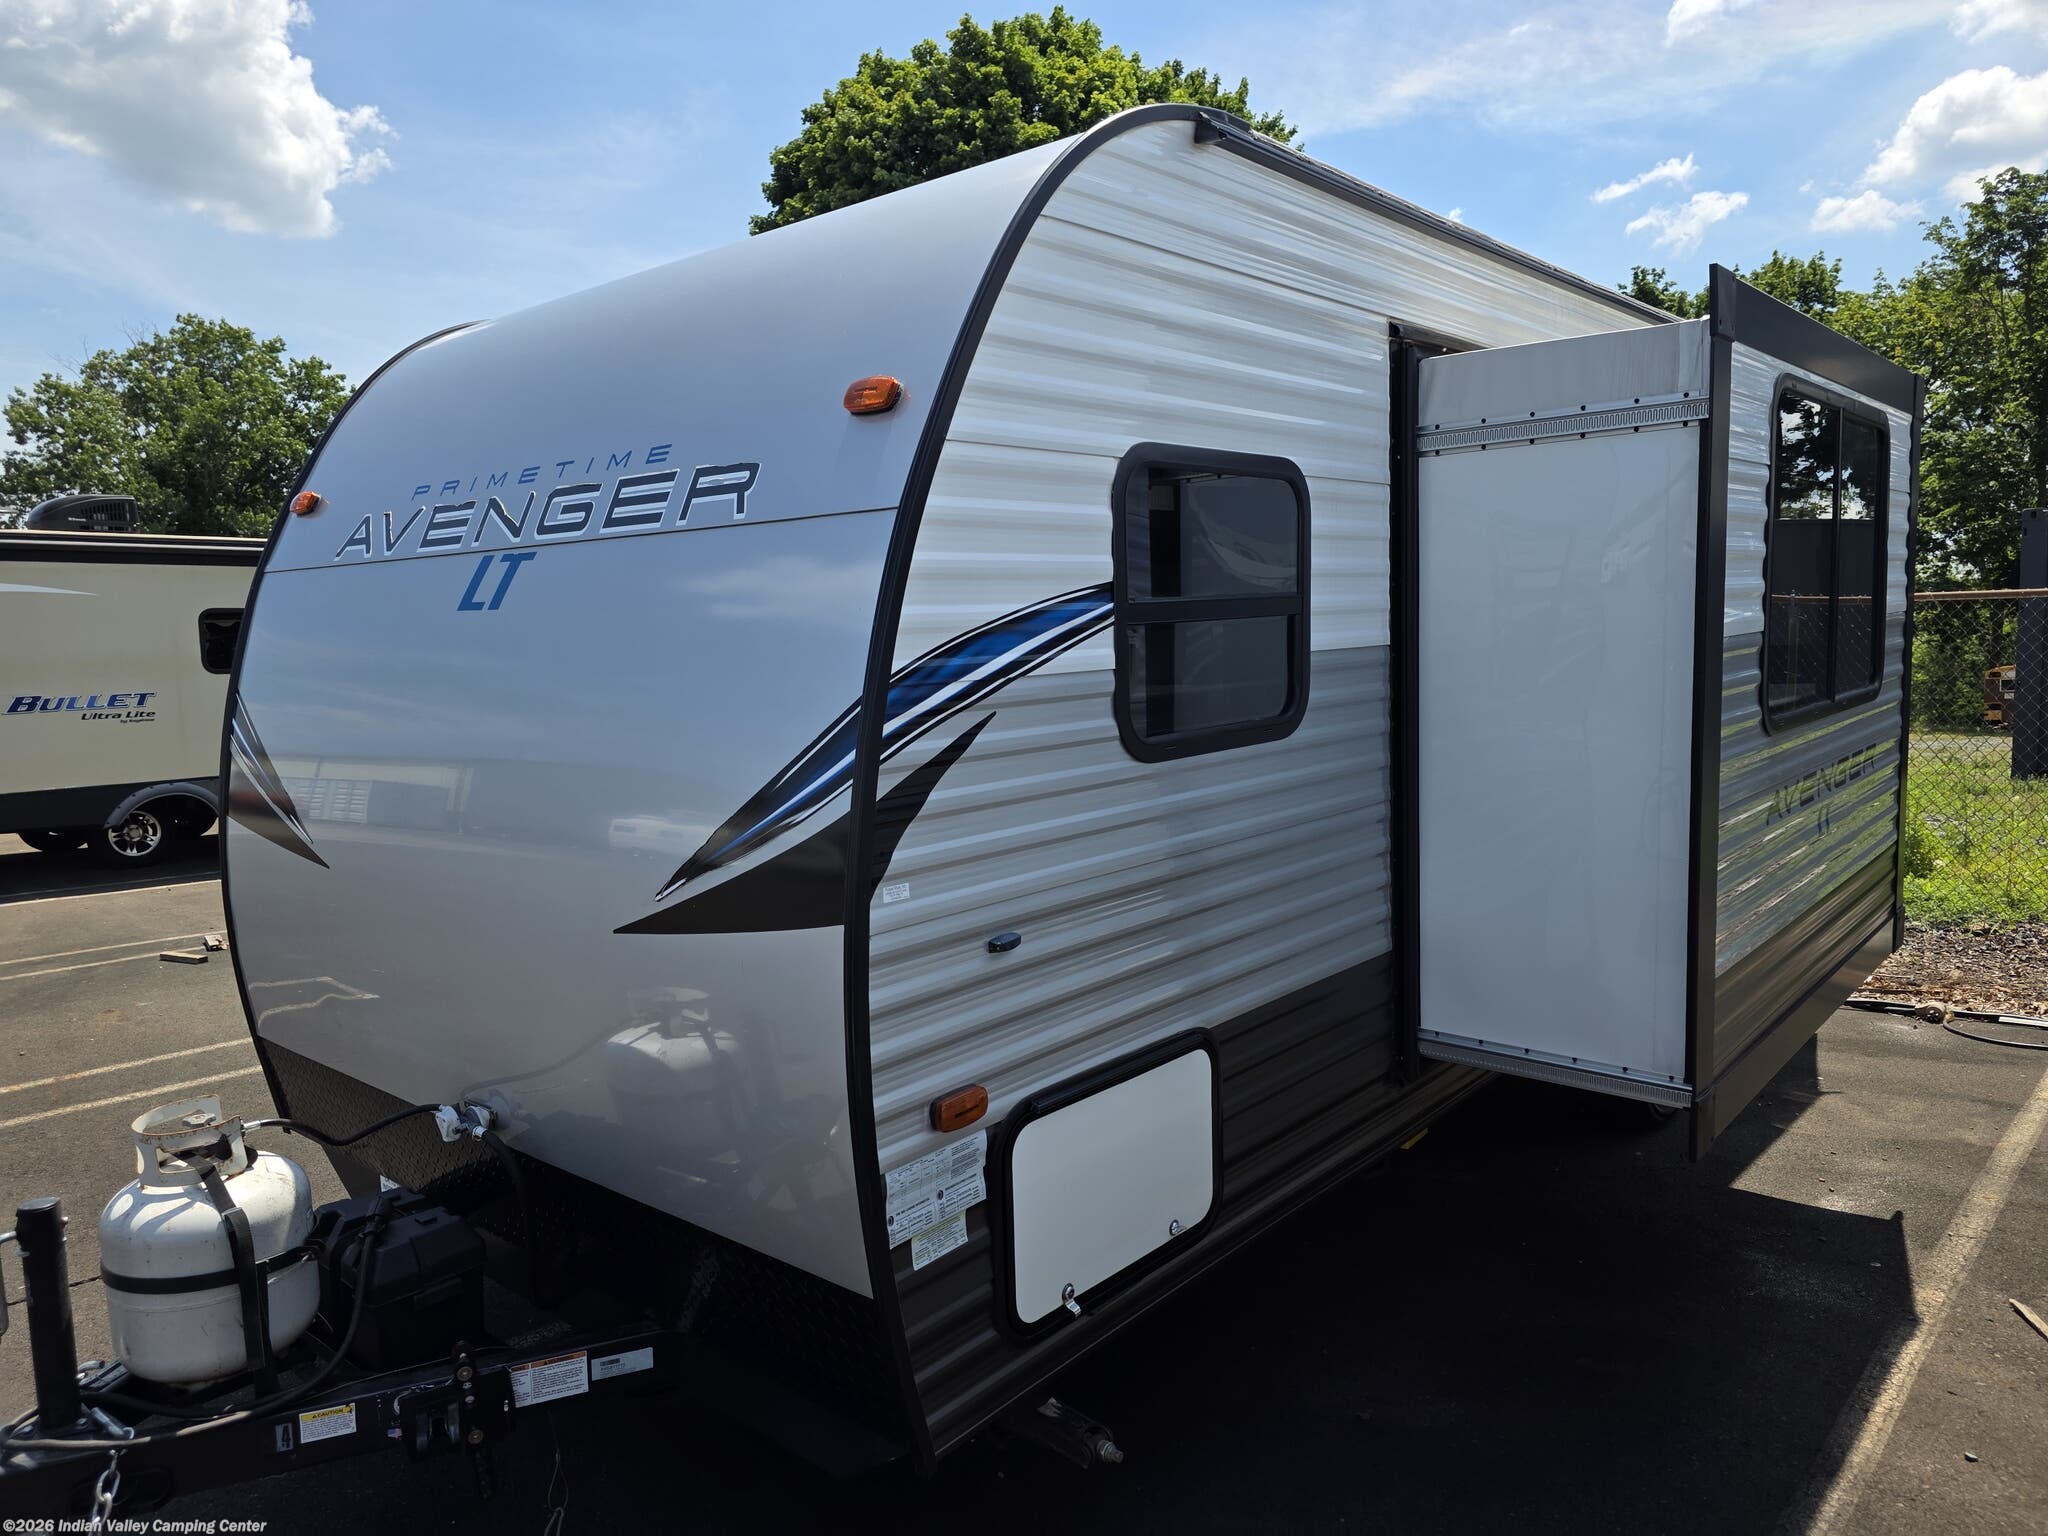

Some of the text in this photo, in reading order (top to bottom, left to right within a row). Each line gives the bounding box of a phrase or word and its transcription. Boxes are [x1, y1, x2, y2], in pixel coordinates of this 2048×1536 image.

[411, 444, 673, 501] PRIMETIME
[334, 462, 762, 561] AVENGER
[456, 552, 538, 612] LT
[3, 692, 157, 715] BULLET
[81, 712, 122, 721] Ultra
[125, 711, 156, 719] Lite
[1766, 743, 1877, 826] AVENGER
[317, 1408, 344, 1418] CAUTION
